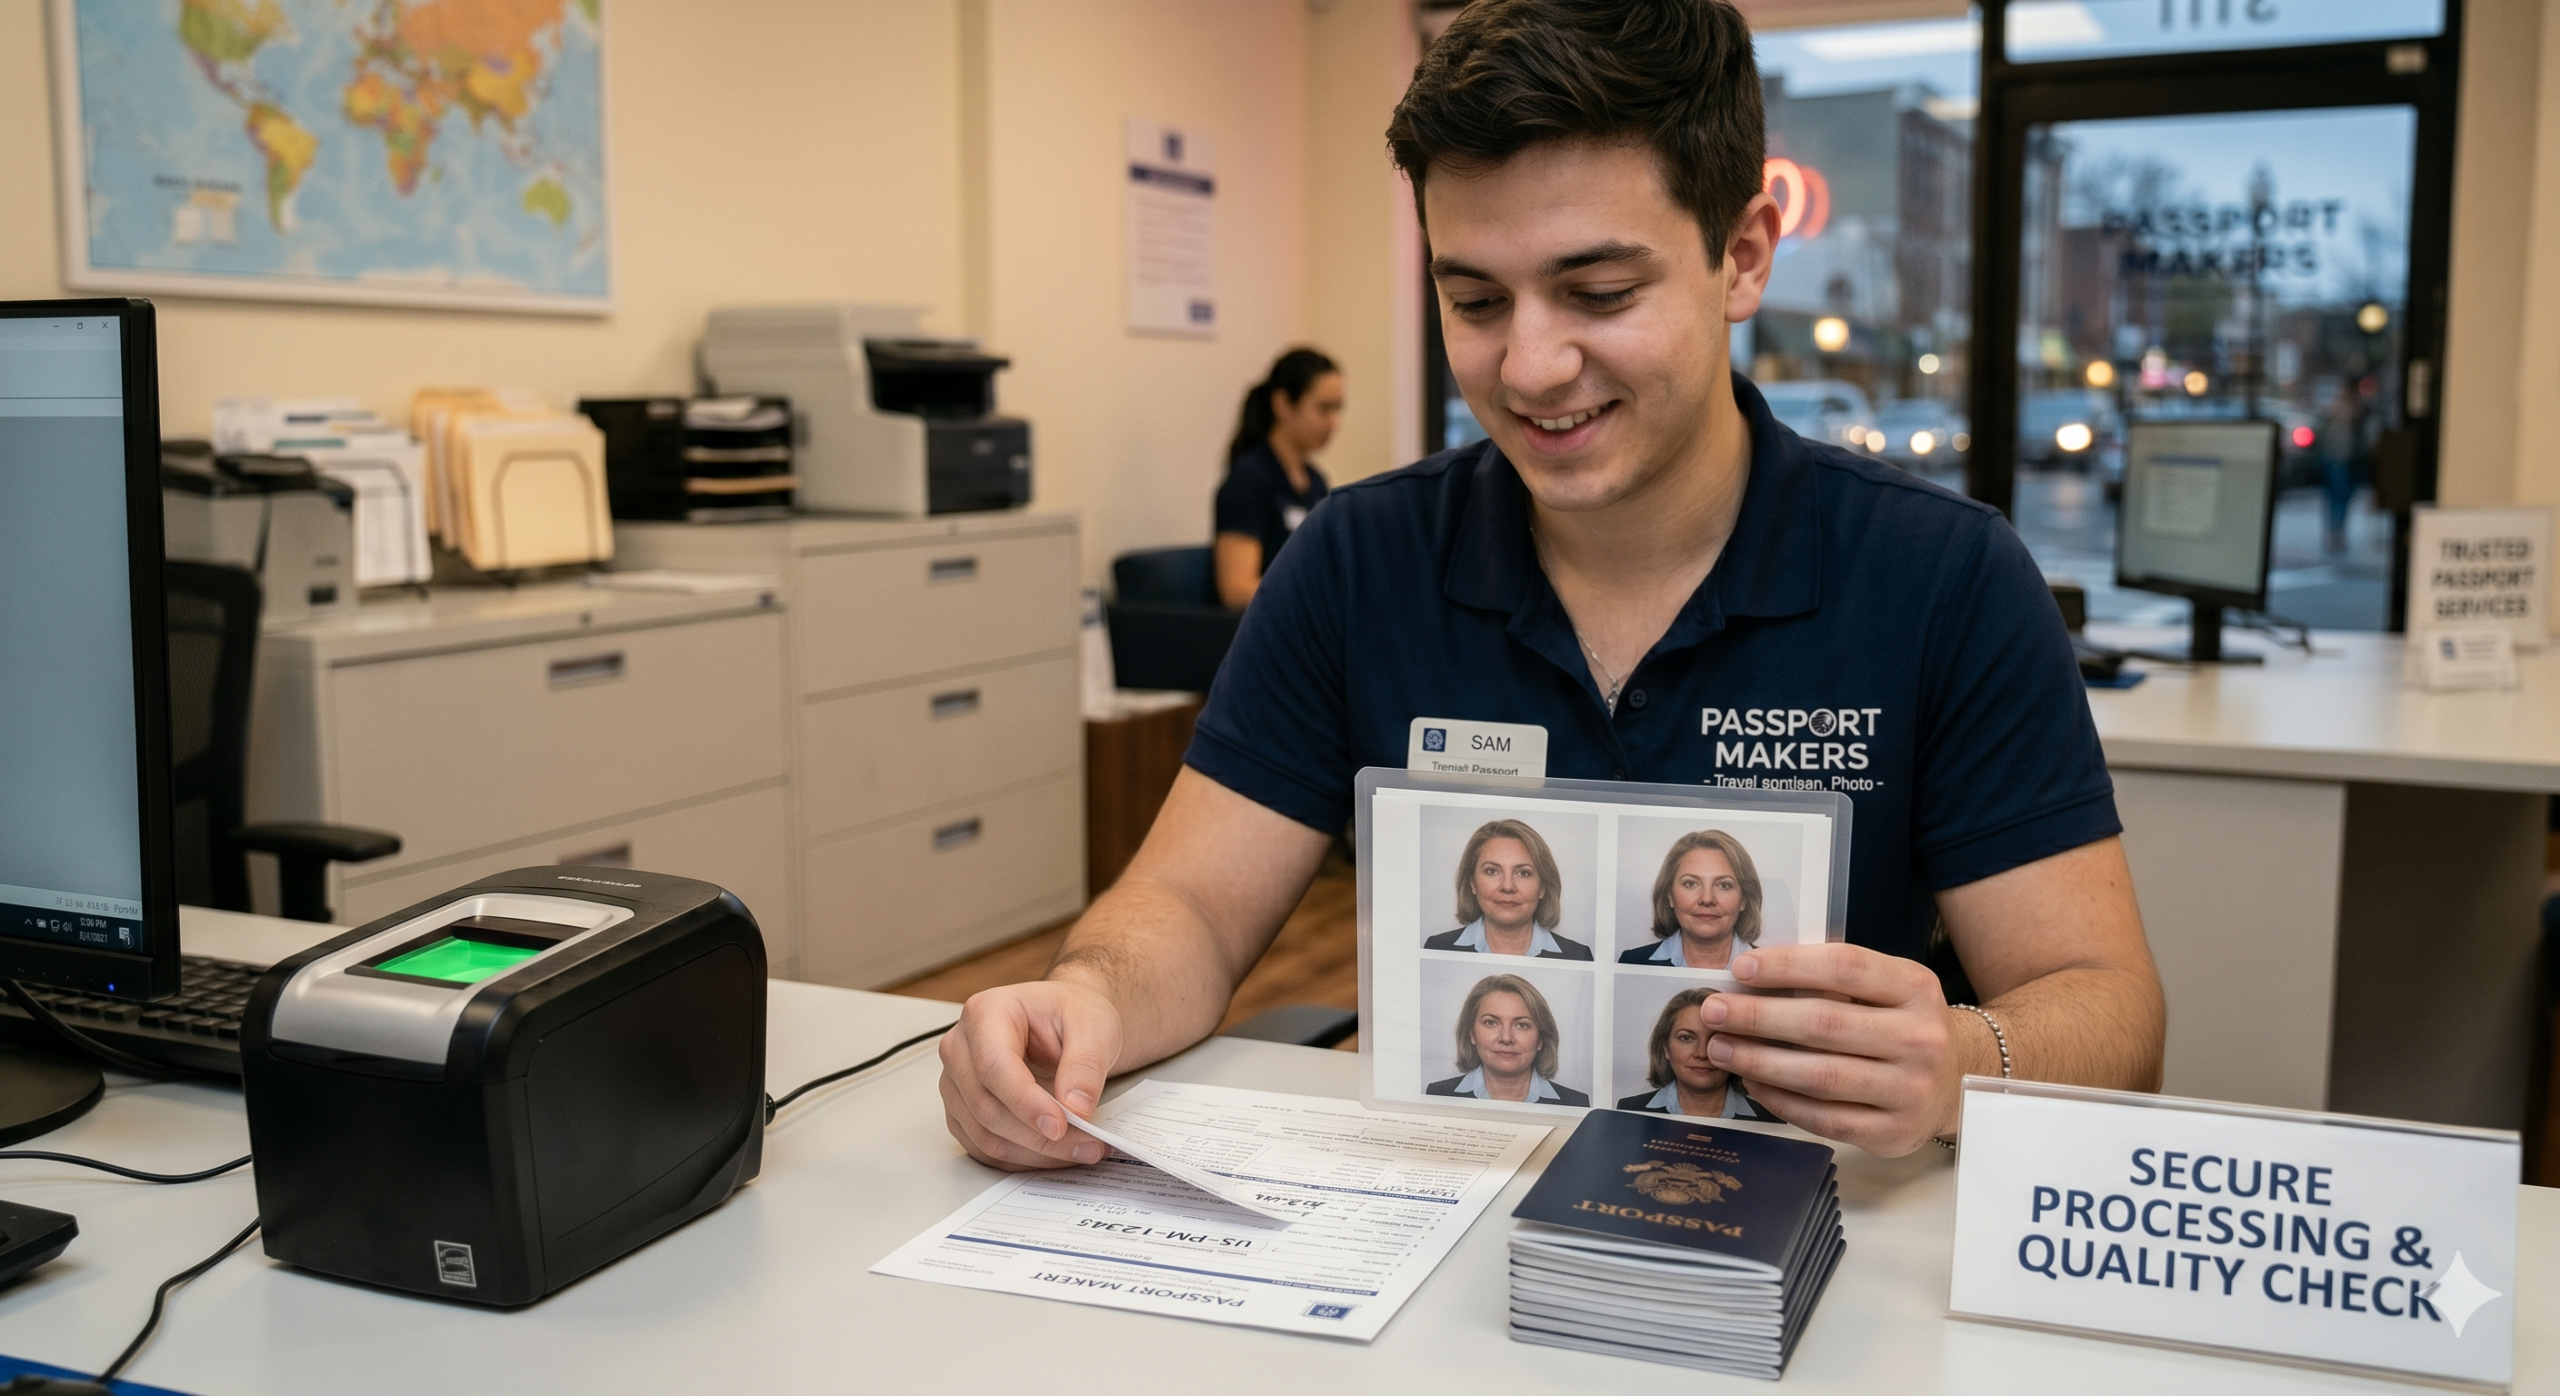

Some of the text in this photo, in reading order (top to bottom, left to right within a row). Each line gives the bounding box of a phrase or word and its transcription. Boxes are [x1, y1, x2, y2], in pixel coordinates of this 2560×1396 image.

[2101, 199, 2342, 236] PASSPORT
[2119, 242, 2317, 276] MAKERS
[2440, 537, 2532, 561] TRUSTED
[2431, 565, 2535, 589] PASSPORT
[2435, 593, 2530, 619] SERVICES
[1701, 707, 1882, 737] PASSPORT
[1471, 734, 1511, 752] SAM
[1715, 741, 1870, 770] MAKERS
[1714, 773, 1757, 790] Travel
[1831, 776, 1873, 791] Photo
[2128, 1147, 2334, 1207] SECURE
[1076, 1218, 1253, 1248] US-PM-12345
[1572, 1199, 1744, 1238] PASSPORT
[2030, 1186, 2433, 1269] PROCESSING &
[1028, 1271, 1122, 1291] MAKERT
[2017, 1234, 2442, 1323] QUALITY CHECK
[1124, 1284, 1246, 1308] PASSPORT
